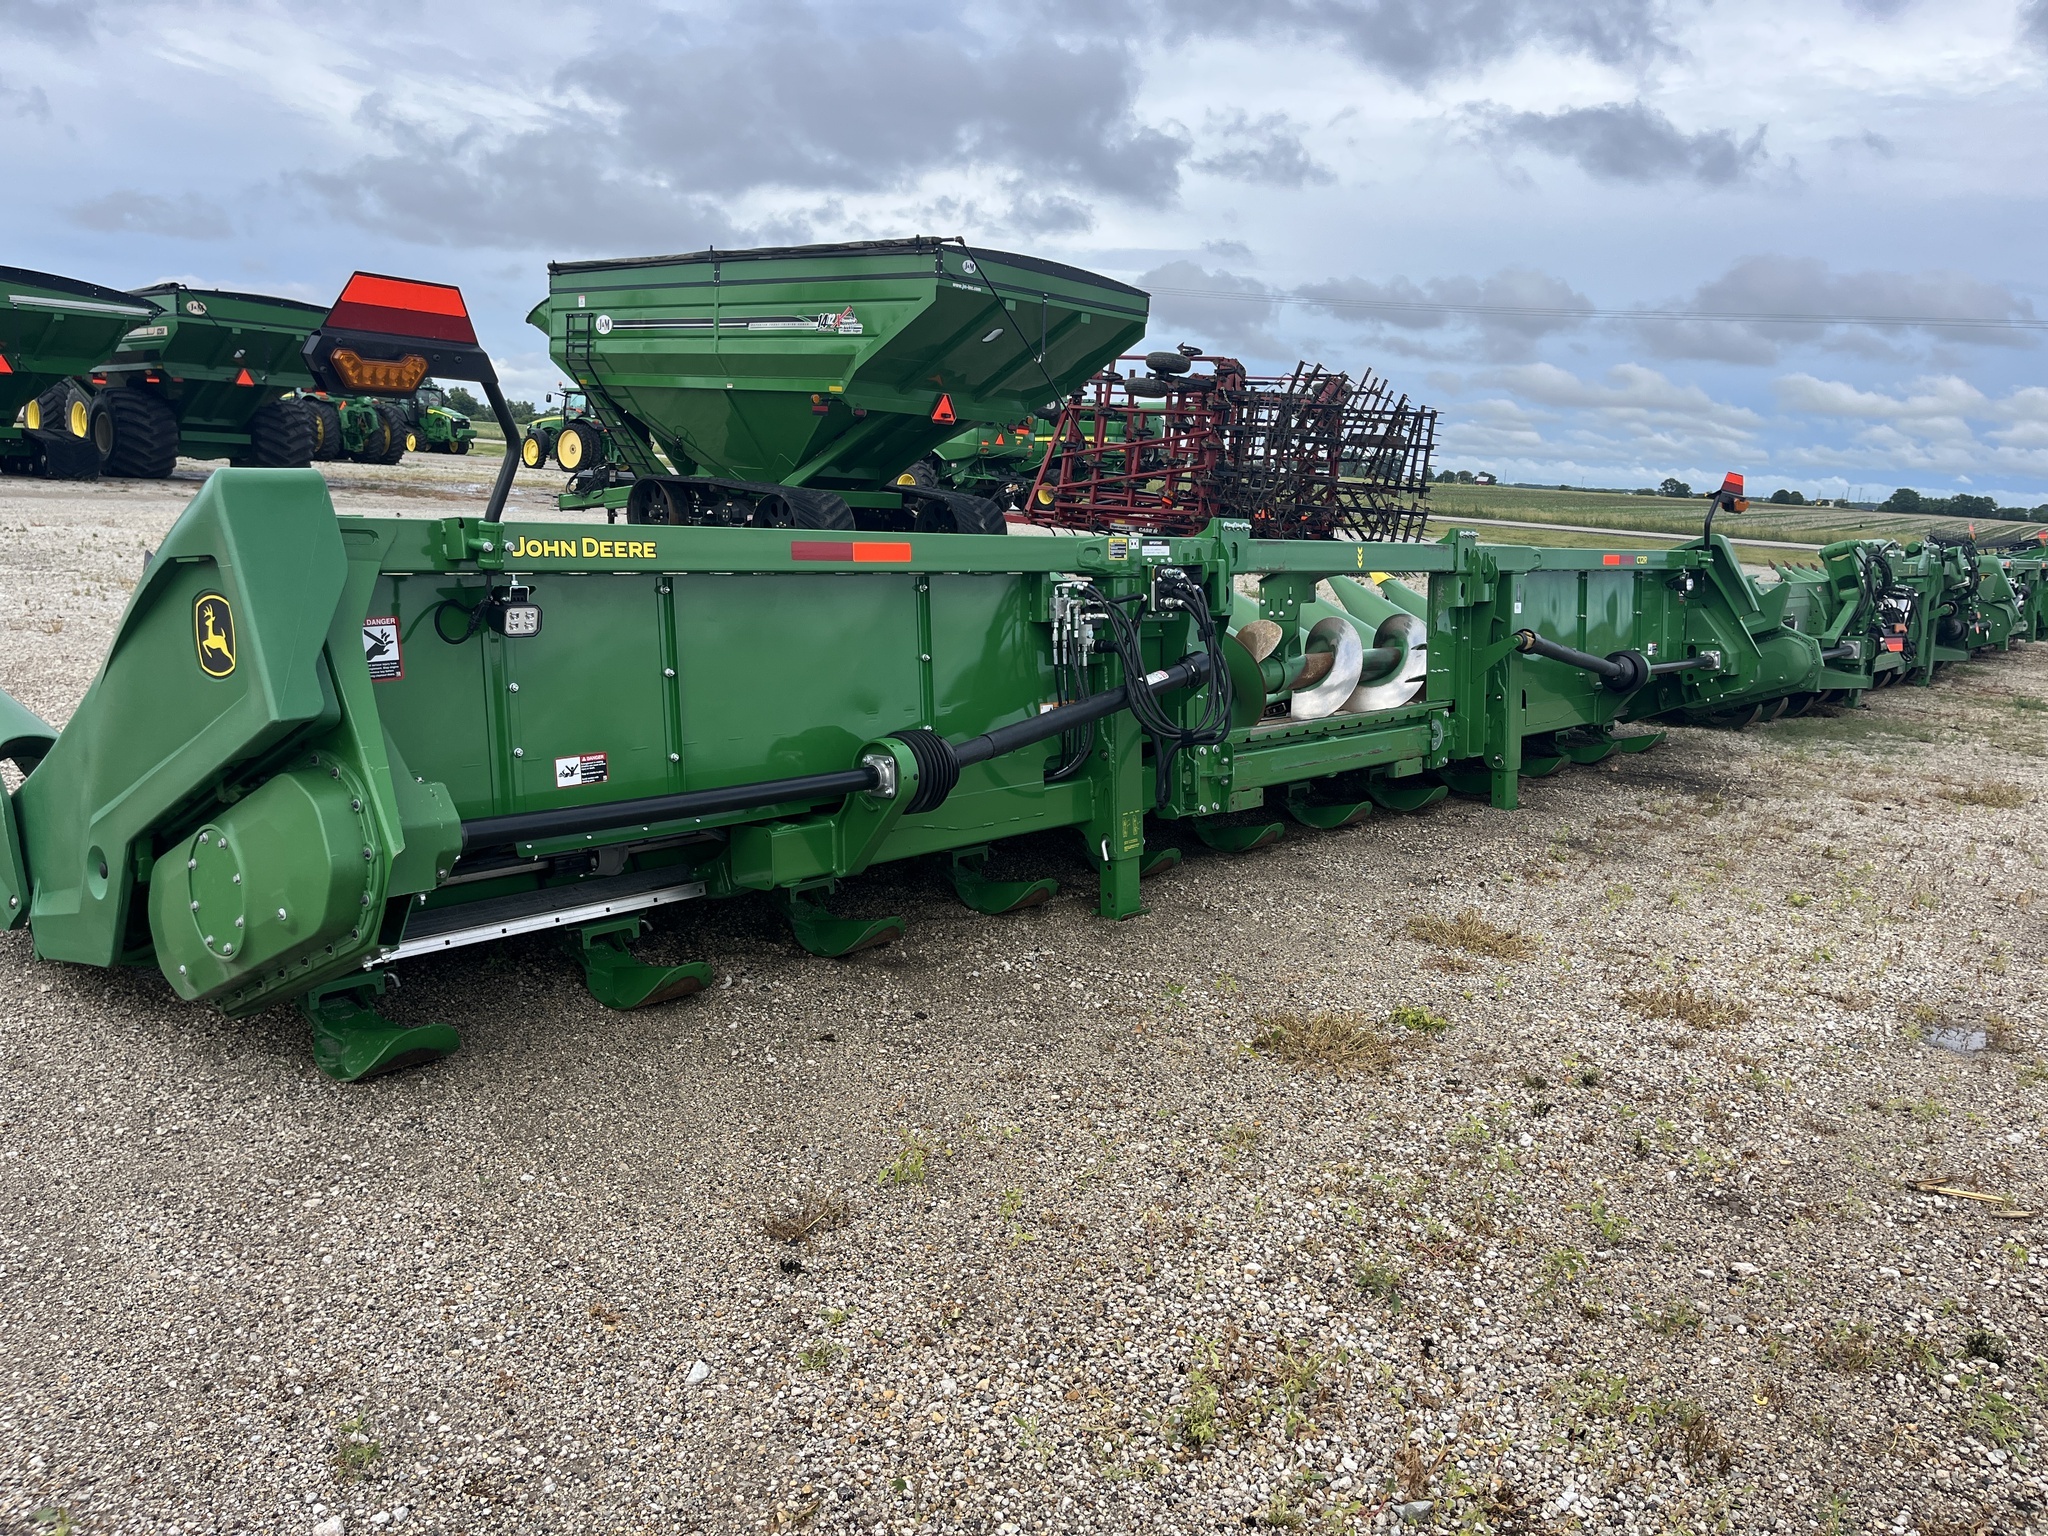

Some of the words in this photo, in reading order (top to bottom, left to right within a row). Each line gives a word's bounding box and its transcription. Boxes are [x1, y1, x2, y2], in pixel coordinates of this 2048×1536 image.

[598, 318, 610, 331] J&M
[512, 536, 577, 558] JOHN
[581, 537, 657, 558] DEERE
[366, 617, 396, 626] DANGER
[586, 754, 605, 762] DANGER
